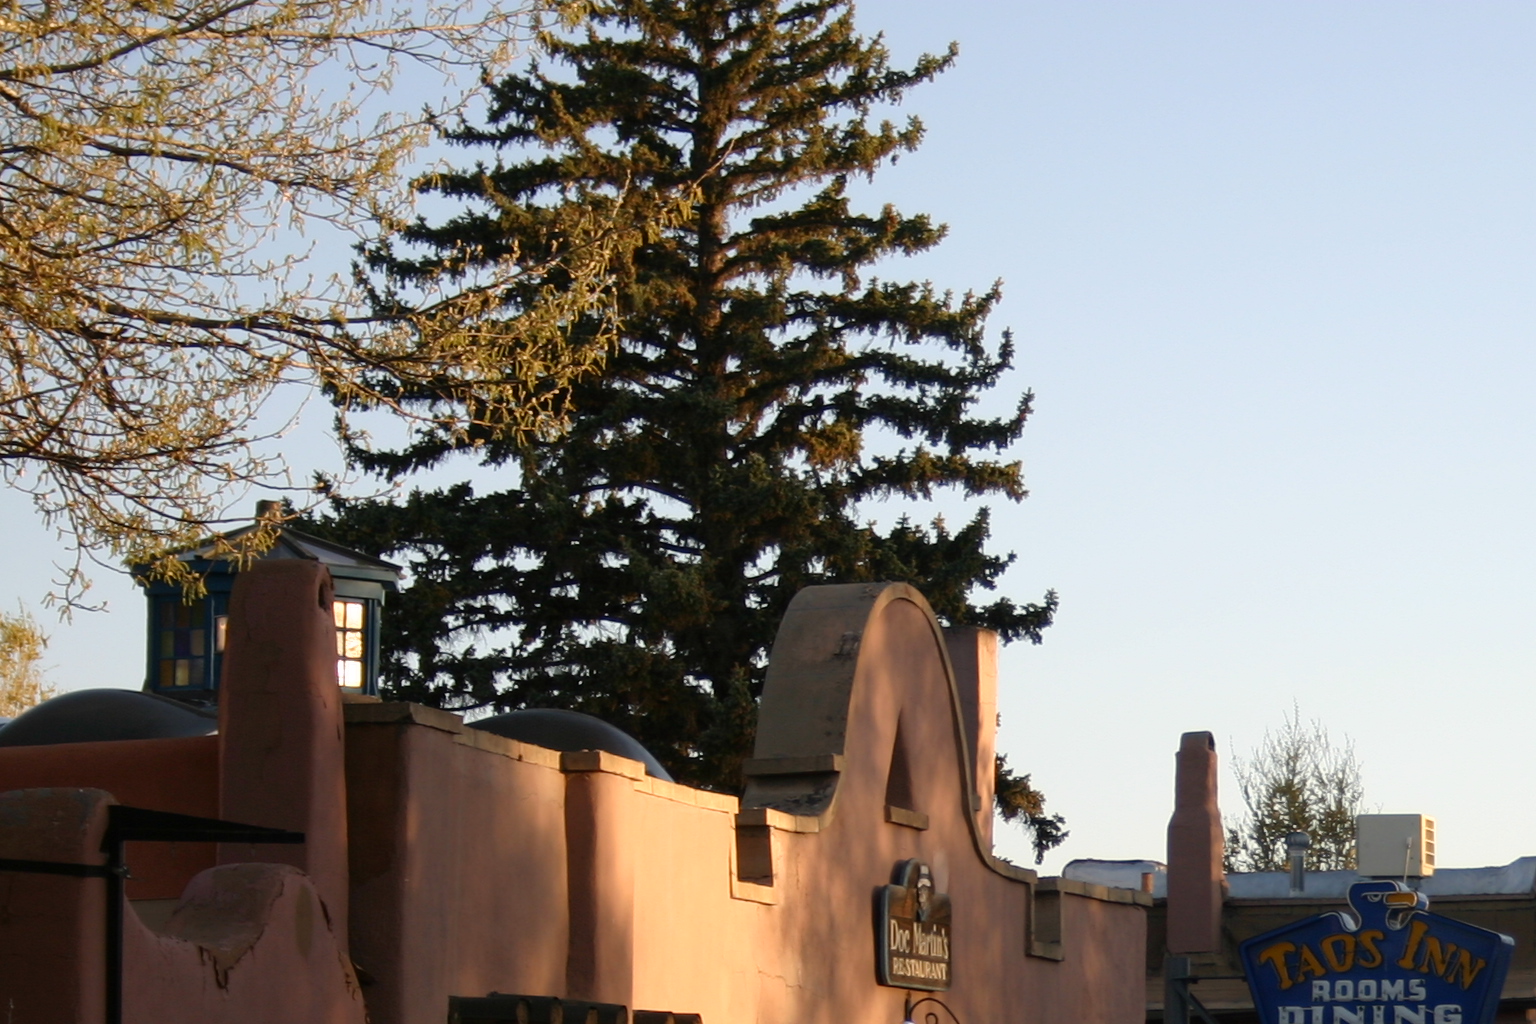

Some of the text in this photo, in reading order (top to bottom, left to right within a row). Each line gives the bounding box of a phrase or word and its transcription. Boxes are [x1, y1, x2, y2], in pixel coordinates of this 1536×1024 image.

[890, 920, 949, 959] Doc Martin's
[893, 957, 947, 980] RESTAURANT
[1257, 921, 1486, 991] TAOS INN
[1312, 979, 1426, 1002] ROOMS
